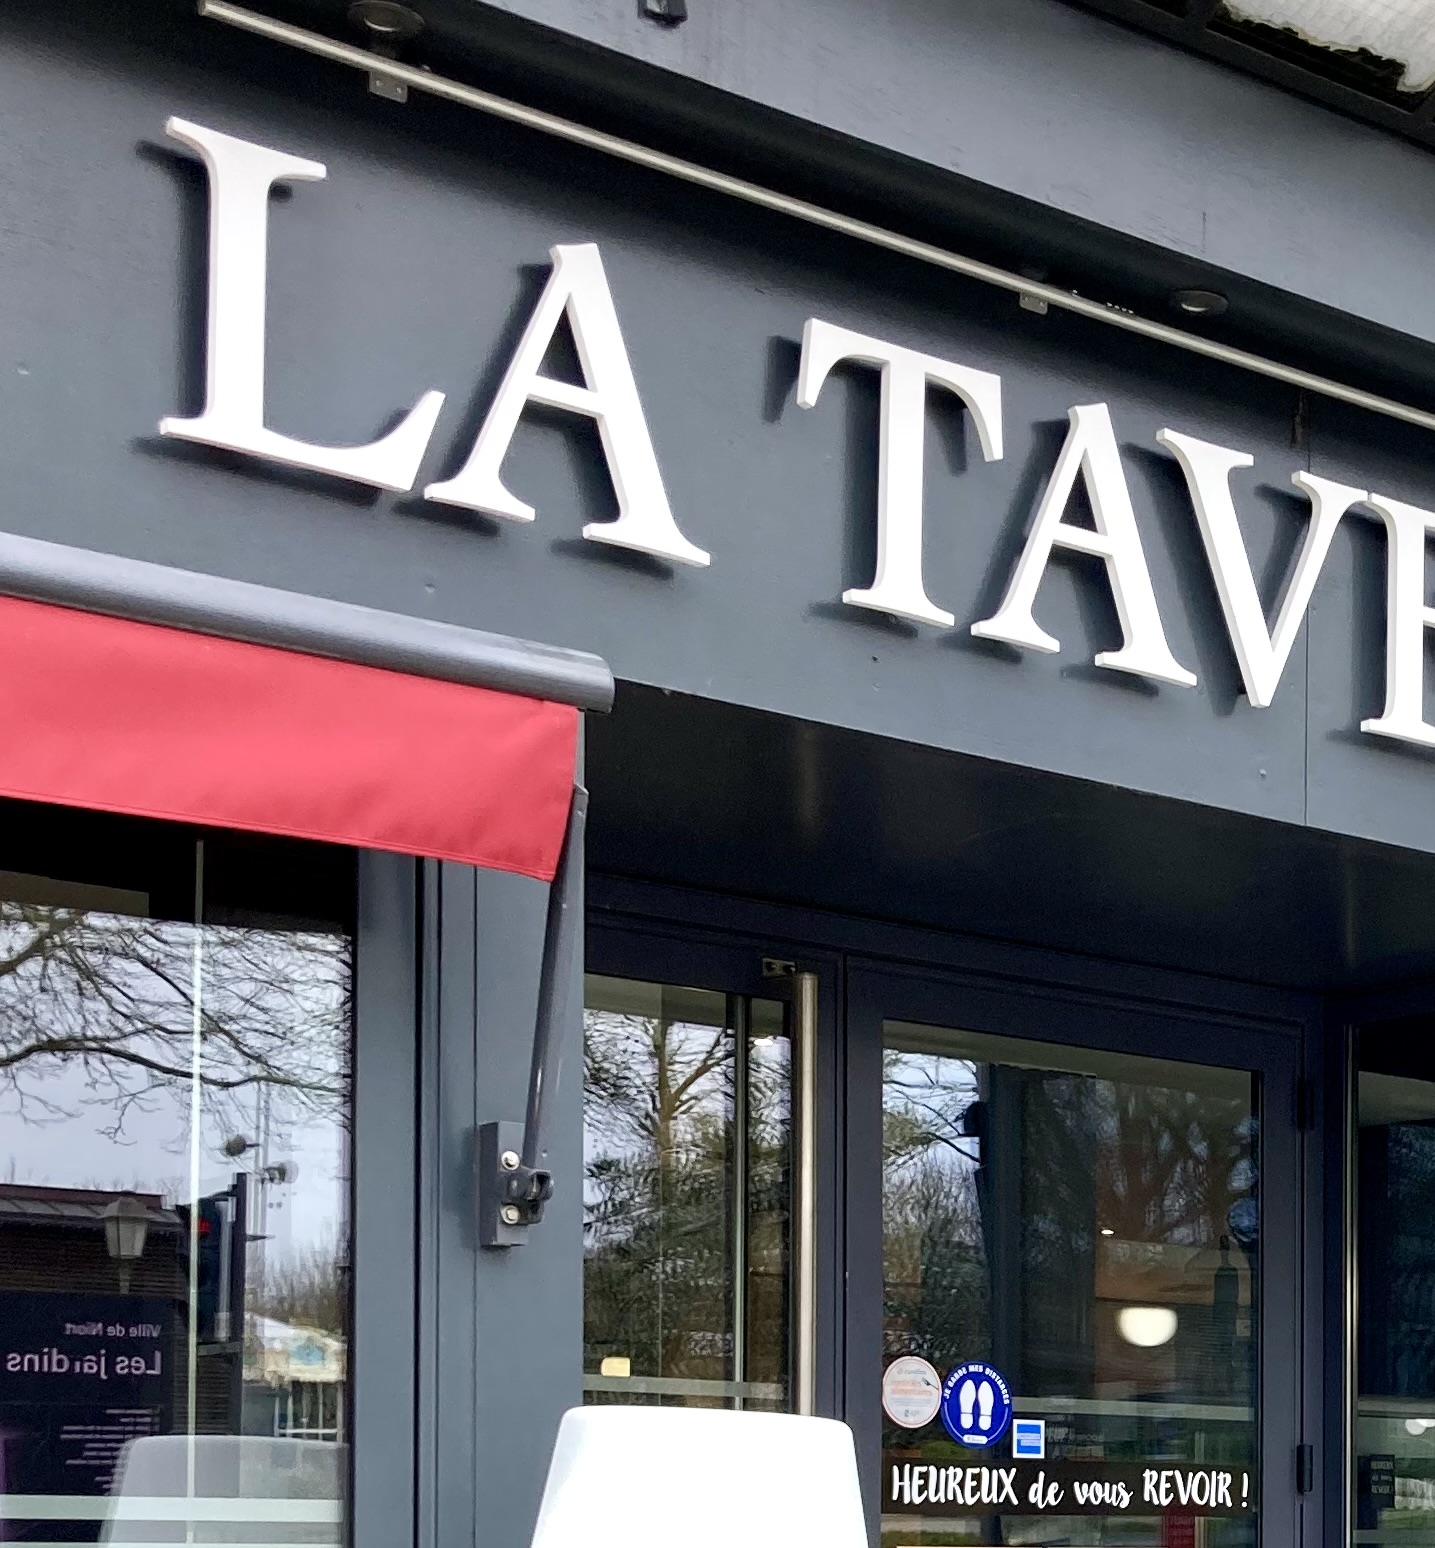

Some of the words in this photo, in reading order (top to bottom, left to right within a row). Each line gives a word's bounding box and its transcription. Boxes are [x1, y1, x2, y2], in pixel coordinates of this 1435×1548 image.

[158, 116, 711, 568] LA
[892, 1463, 1019, 1506] HEUREUX
[1028, 1471, 1064, 1509] de
[1073, 1479, 1133, 1508] vous
[1143, 1468, 1234, 1507] REVOIR
[1241, 1472, 1249, 1508] !
